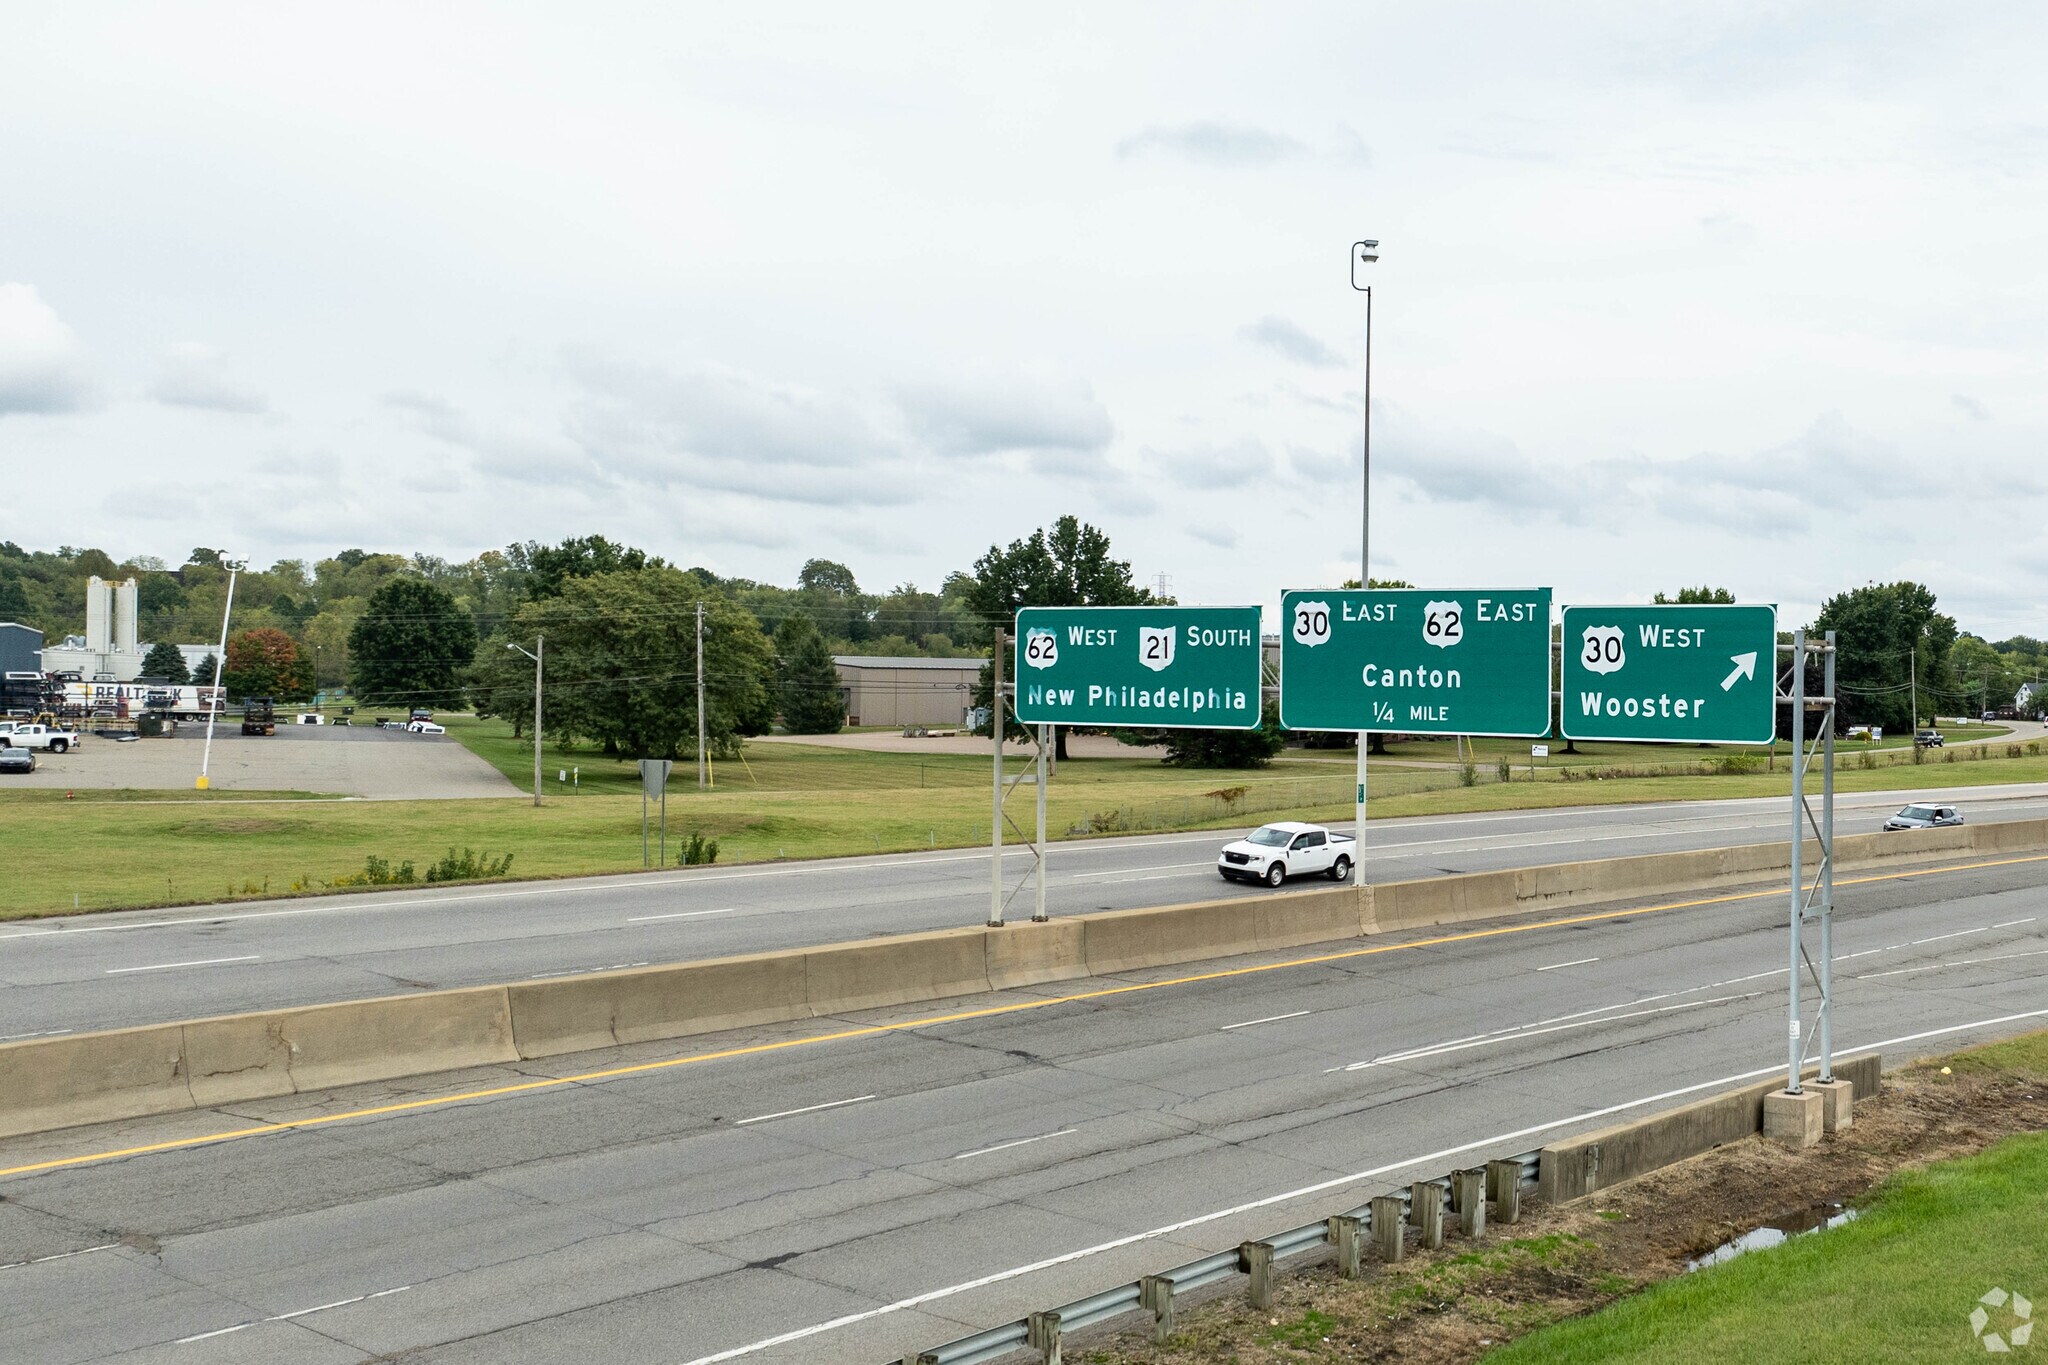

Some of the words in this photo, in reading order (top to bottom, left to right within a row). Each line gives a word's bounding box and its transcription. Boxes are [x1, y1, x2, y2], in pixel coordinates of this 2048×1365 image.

[1297, 611, 1328, 636] 30
[1342, 600, 1397, 622] EAST
[1426, 611, 1459, 637] 62
[1477, 599, 1537, 622] EAST
[1028, 636, 1055, 659] 62
[1068, 625, 1117, 646] WEST
[1147, 635, 1168, 659] 21
[1187, 625, 1251, 647] SOUTH
[1585, 636, 1621, 663] 30
[1639, 624, 1705, 648] WEST
[1362, 663, 1461, 688] Canton
[96, 686, 182, 700] REALTK
[1028, 684, 1075, 706] New
[1088, 685, 1246, 713] Philadelphia
[1580, 692, 1705, 719] Wooster
[1410, 706, 1449, 721] MILE
